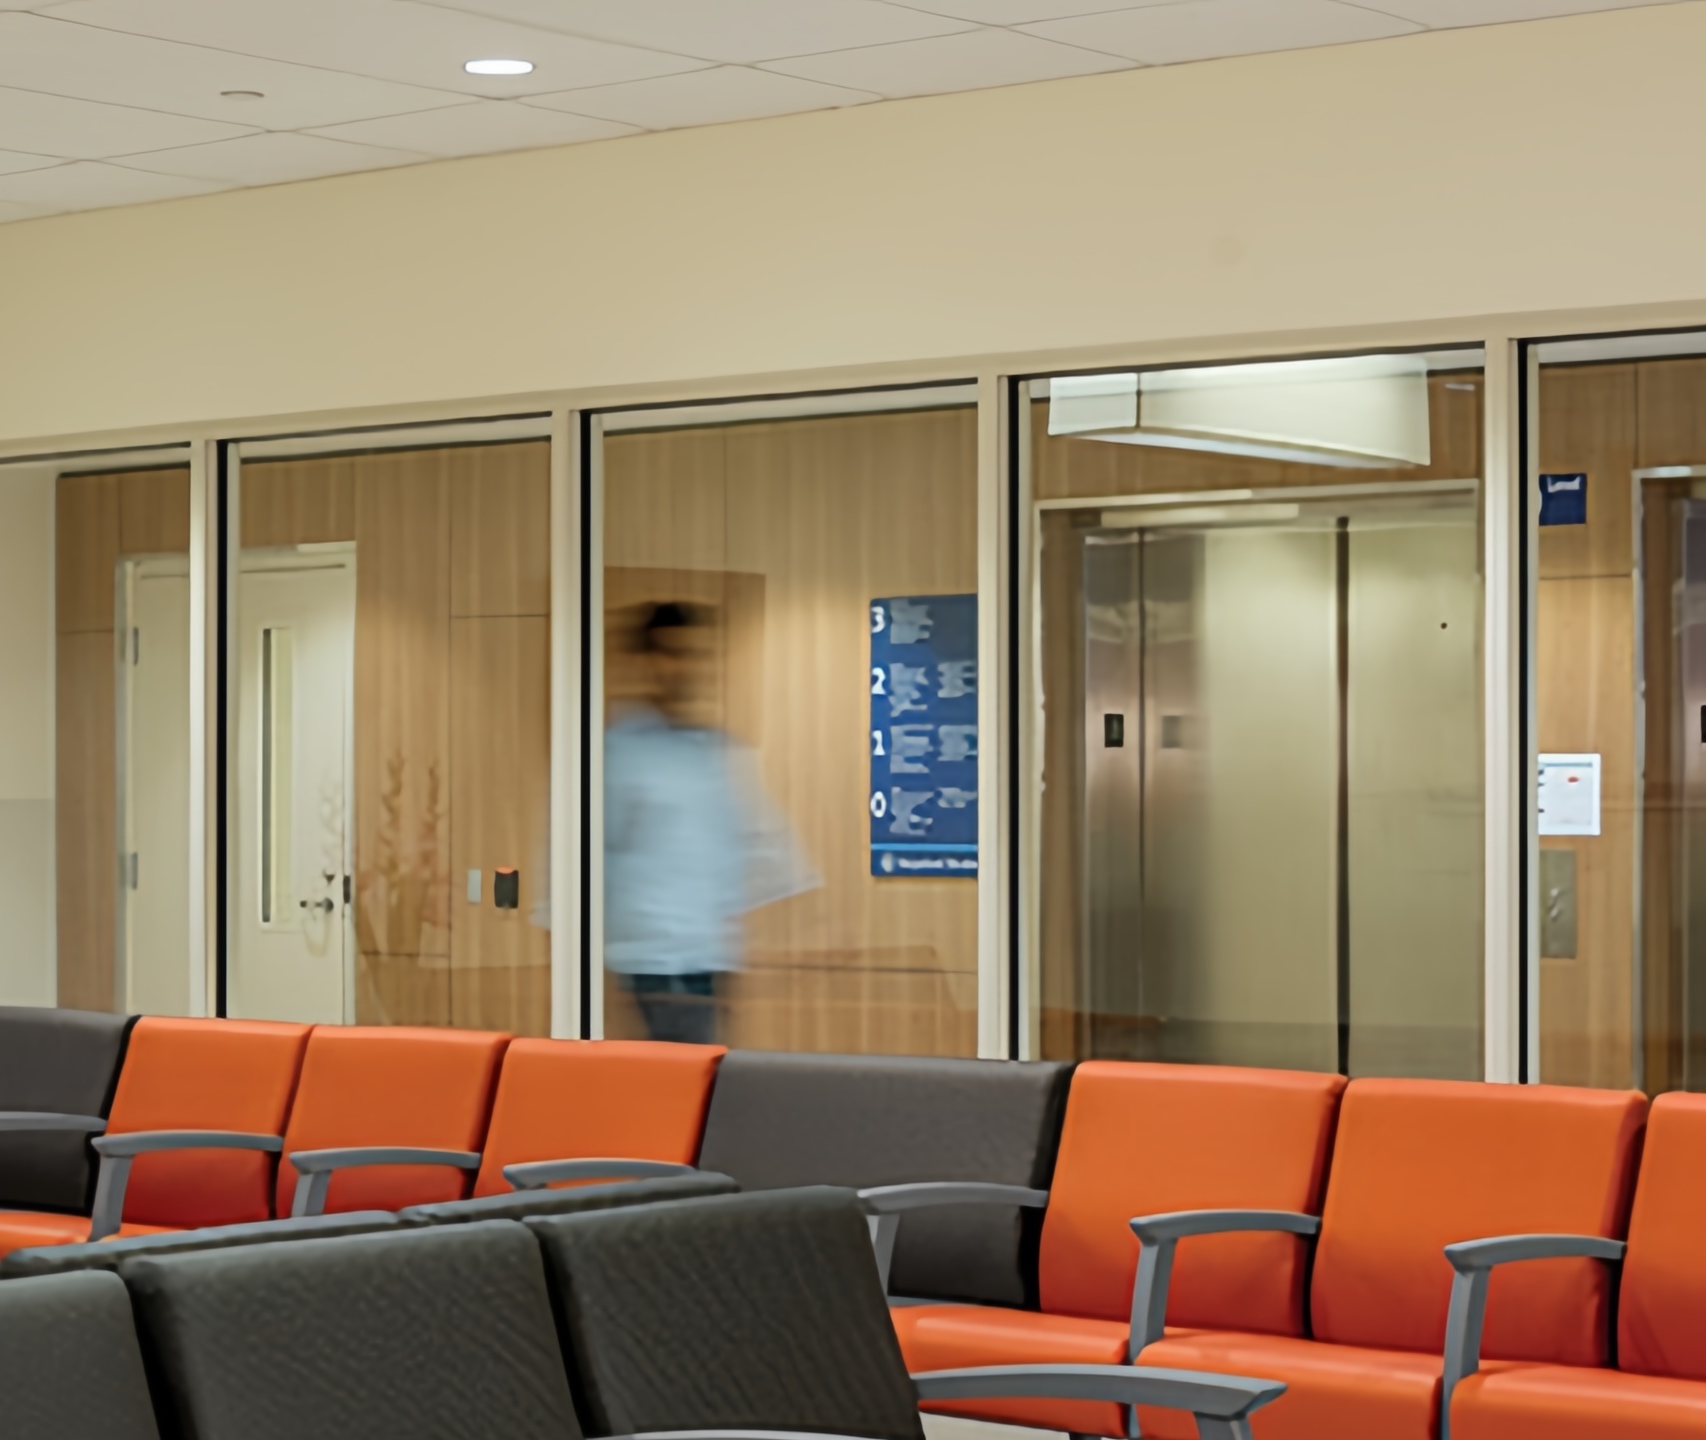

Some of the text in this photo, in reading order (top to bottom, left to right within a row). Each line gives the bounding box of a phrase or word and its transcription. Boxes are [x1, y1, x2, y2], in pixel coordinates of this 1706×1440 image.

[871, 606, 886, 633] 3
[871, 667, 886, 695] 2
[873, 730, 886, 756] 1
[871, 791, 886, 818] 0
